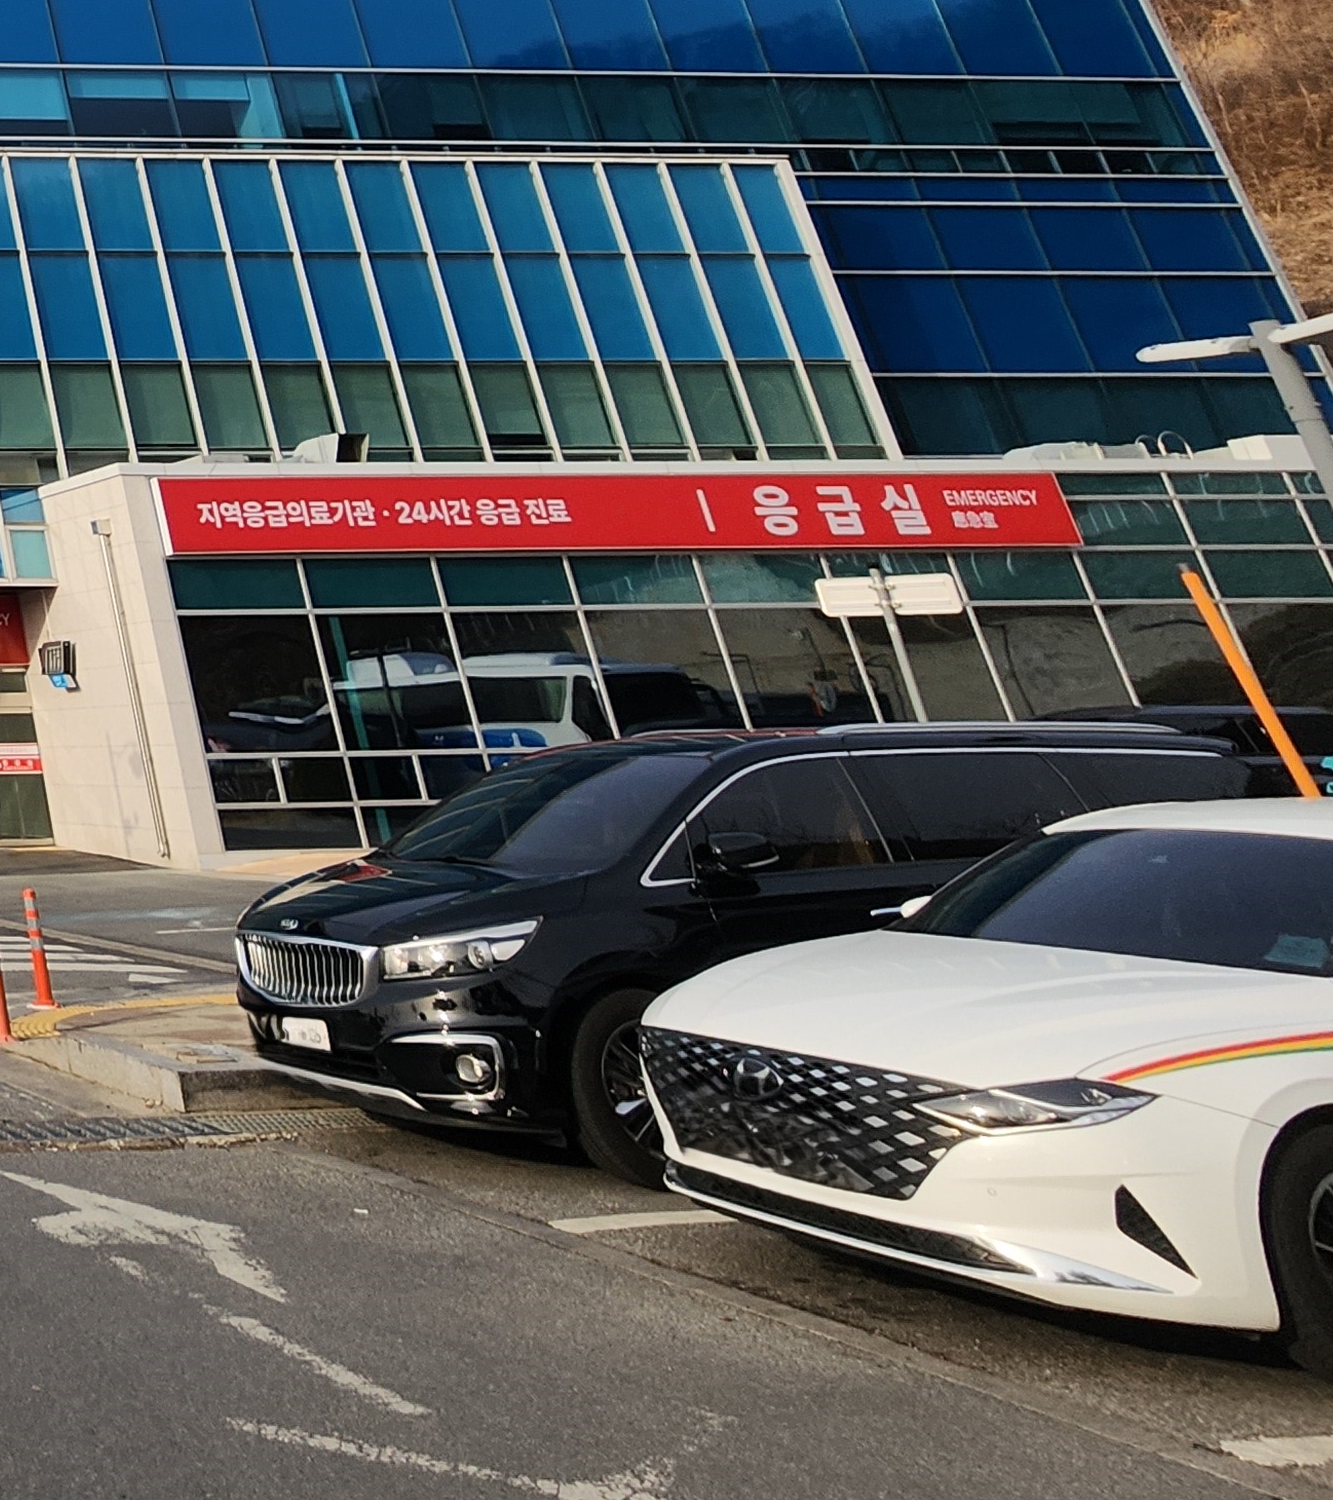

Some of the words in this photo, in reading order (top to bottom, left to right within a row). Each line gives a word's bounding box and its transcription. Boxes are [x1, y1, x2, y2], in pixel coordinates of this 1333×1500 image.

[197, 499, 377, 529] 지역응급의료기관
[395, 499, 473, 527] 24시간
[476, 498, 521, 526] 응급
[524, 498, 573, 525] 진료
[752, 484, 933, 537] 응급실
[942, 490, 1037, 507] EMERGENCY
